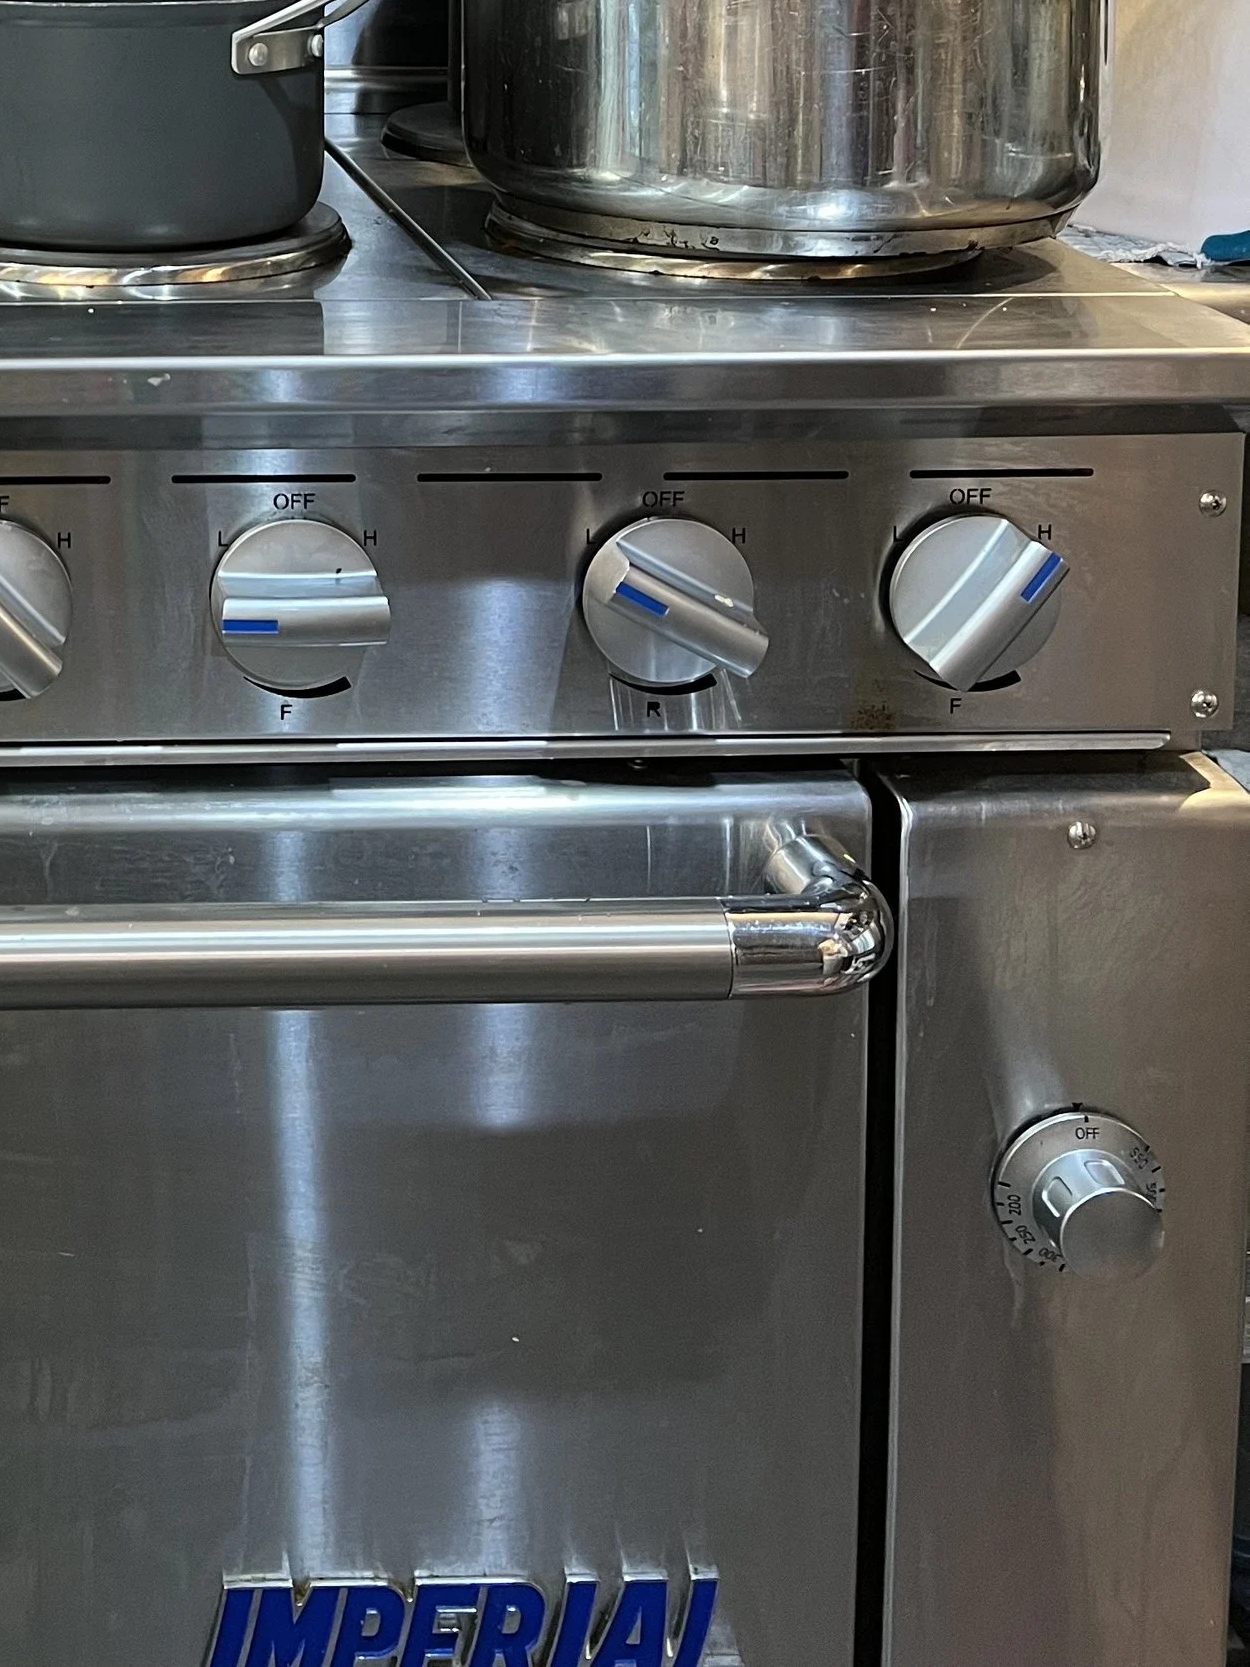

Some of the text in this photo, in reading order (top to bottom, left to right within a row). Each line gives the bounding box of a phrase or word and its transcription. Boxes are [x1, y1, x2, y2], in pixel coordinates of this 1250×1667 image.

[274, 493, 315, 510] OFF
[643, 490, 684, 508] OFF
[949, 487, 992, 505] OFF
[58, 532, 71, 549] H
[219, 530, 228, 547] L
[364, 530, 377, 547] H
[586, 527, 596, 546] L
[733, 527, 745, 545] H
[893, 524, 904, 542] L
[1037, 524, 1052, 541] H
[280, 704, 292, 720] F
[646, 701, 661, 718] R
[949, 697, 962, 715] F
[1075, 1126, 1100, 1140] OFF
[1008, 1194, 1022, 1216] 200
[1015, 1224, 1036, 1245] 250
